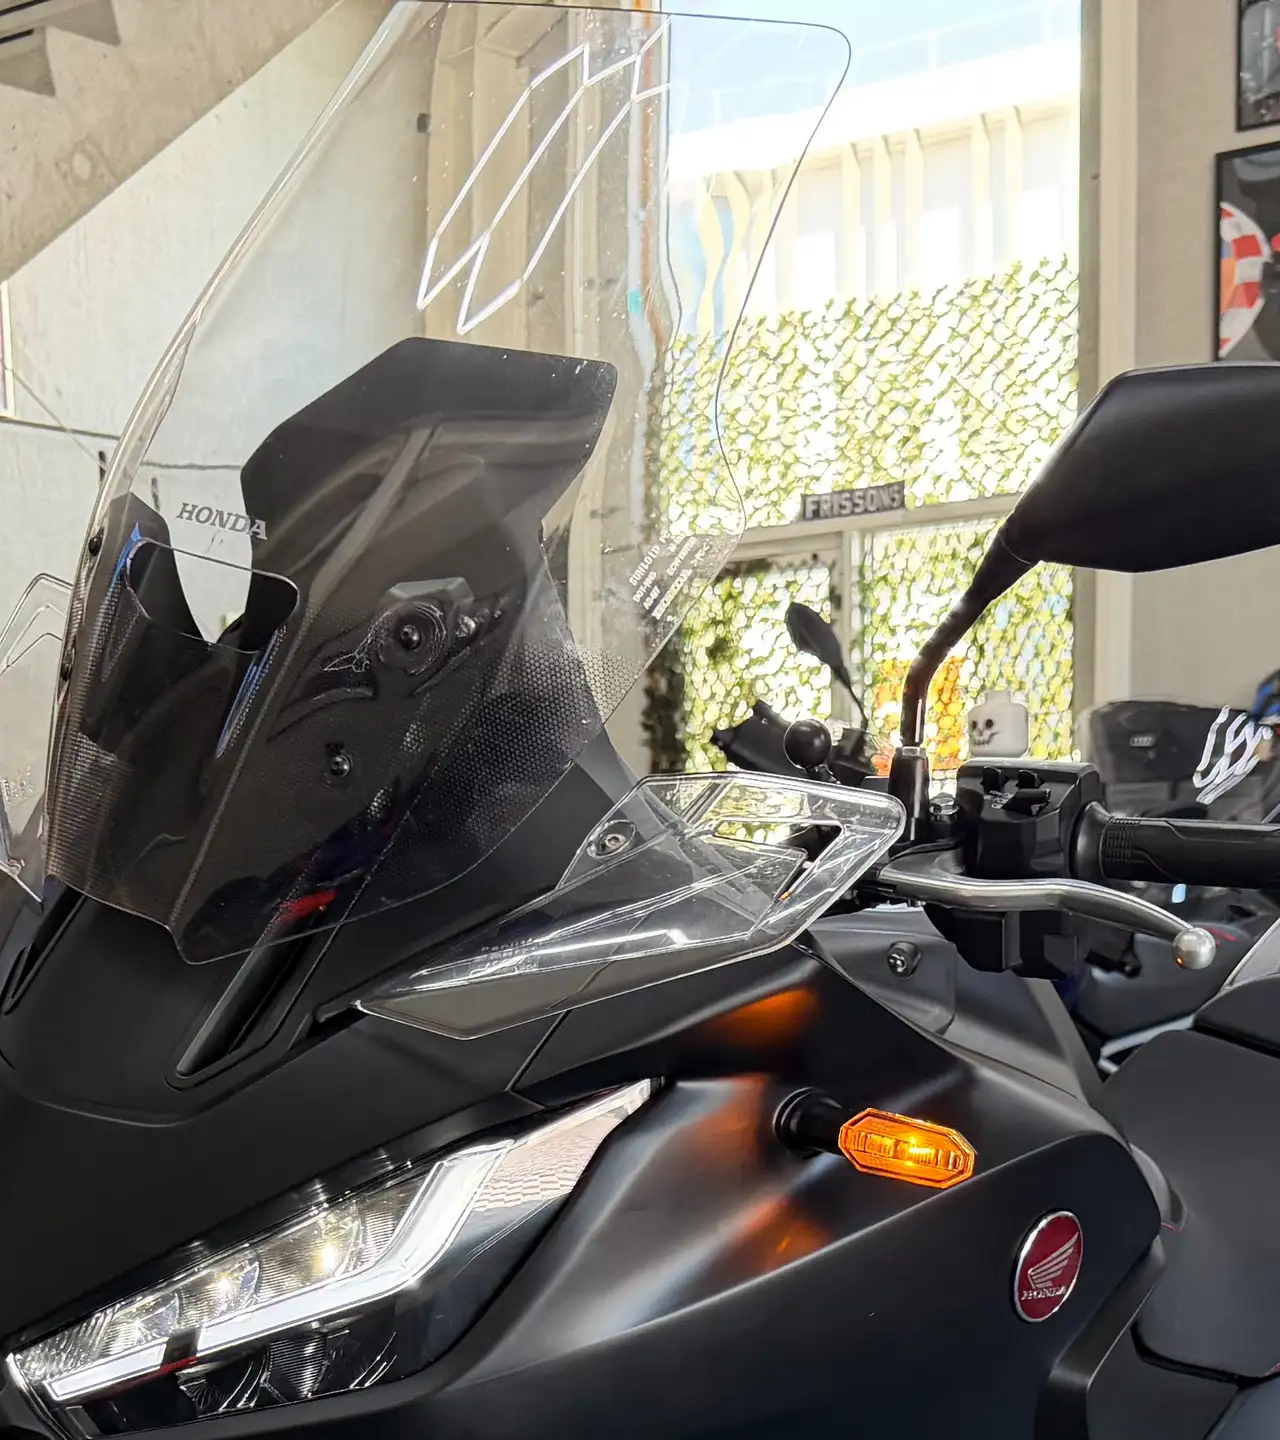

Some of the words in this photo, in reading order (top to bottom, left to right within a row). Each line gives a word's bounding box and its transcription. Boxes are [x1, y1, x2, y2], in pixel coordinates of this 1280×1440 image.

[804, 486, 901, 519] FRISSONS
[176, 502, 268, 540] HONDA
[1021, 1285, 1066, 1301] HONDA
